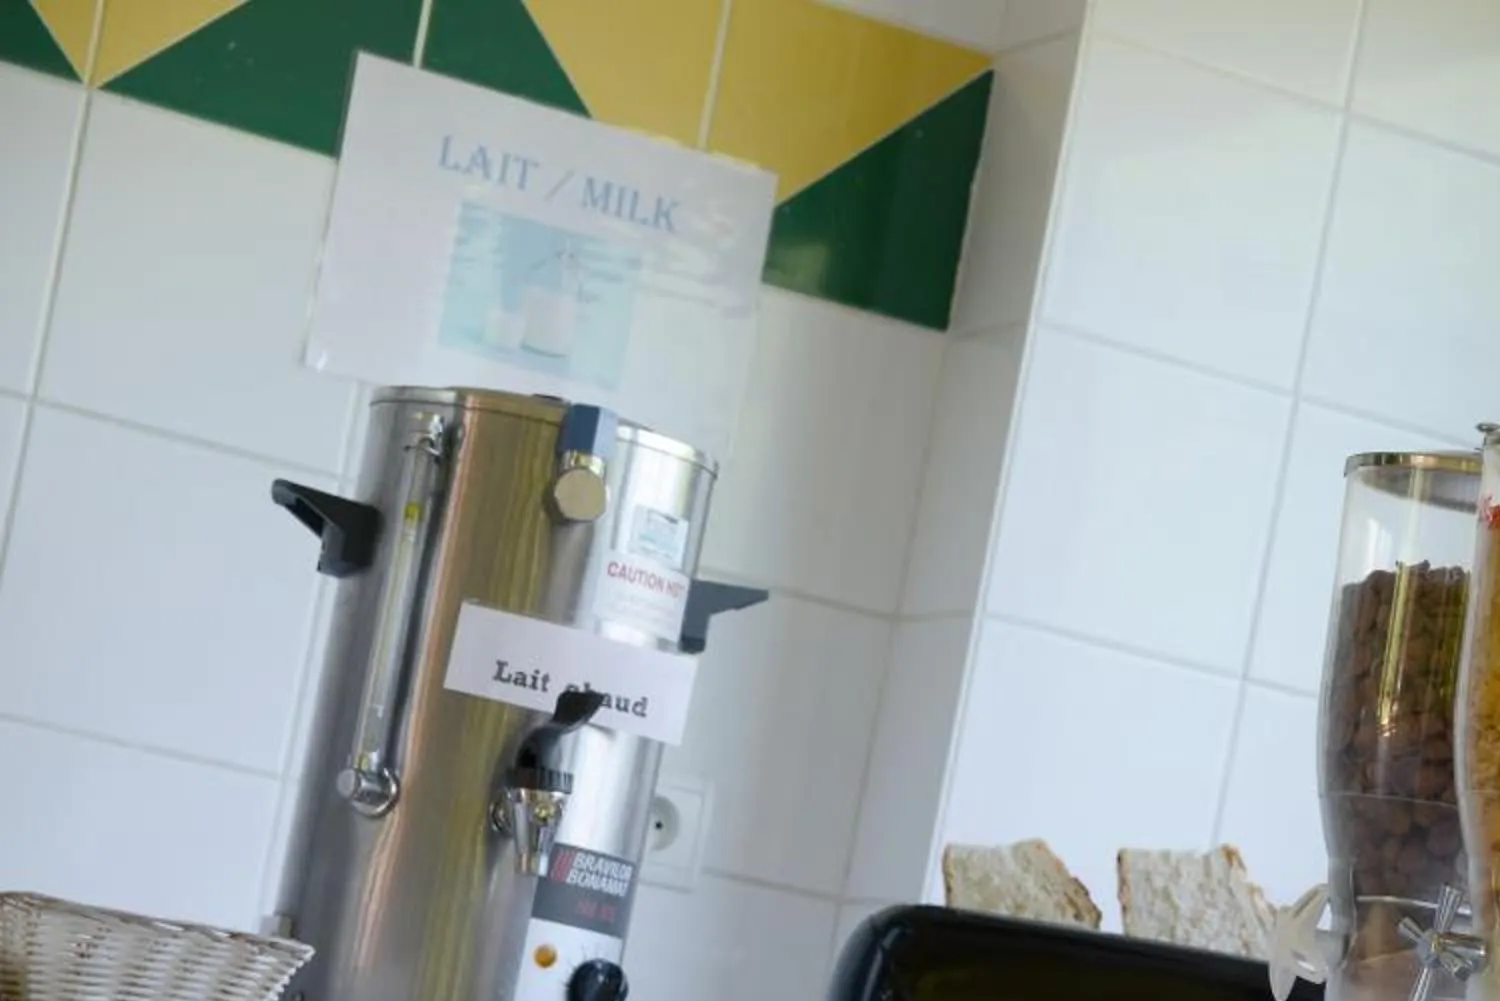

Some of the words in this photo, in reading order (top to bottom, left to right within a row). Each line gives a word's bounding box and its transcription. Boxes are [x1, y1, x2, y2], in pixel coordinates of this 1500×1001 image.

[437, 133, 540, 191] LAIT
[581, 175, 681, 234] MILK
[606, 560, 665, 595] CAUTION
[492, 659, 551, 693] Lait
[573, 851, 633, 882] BRAVILOR
